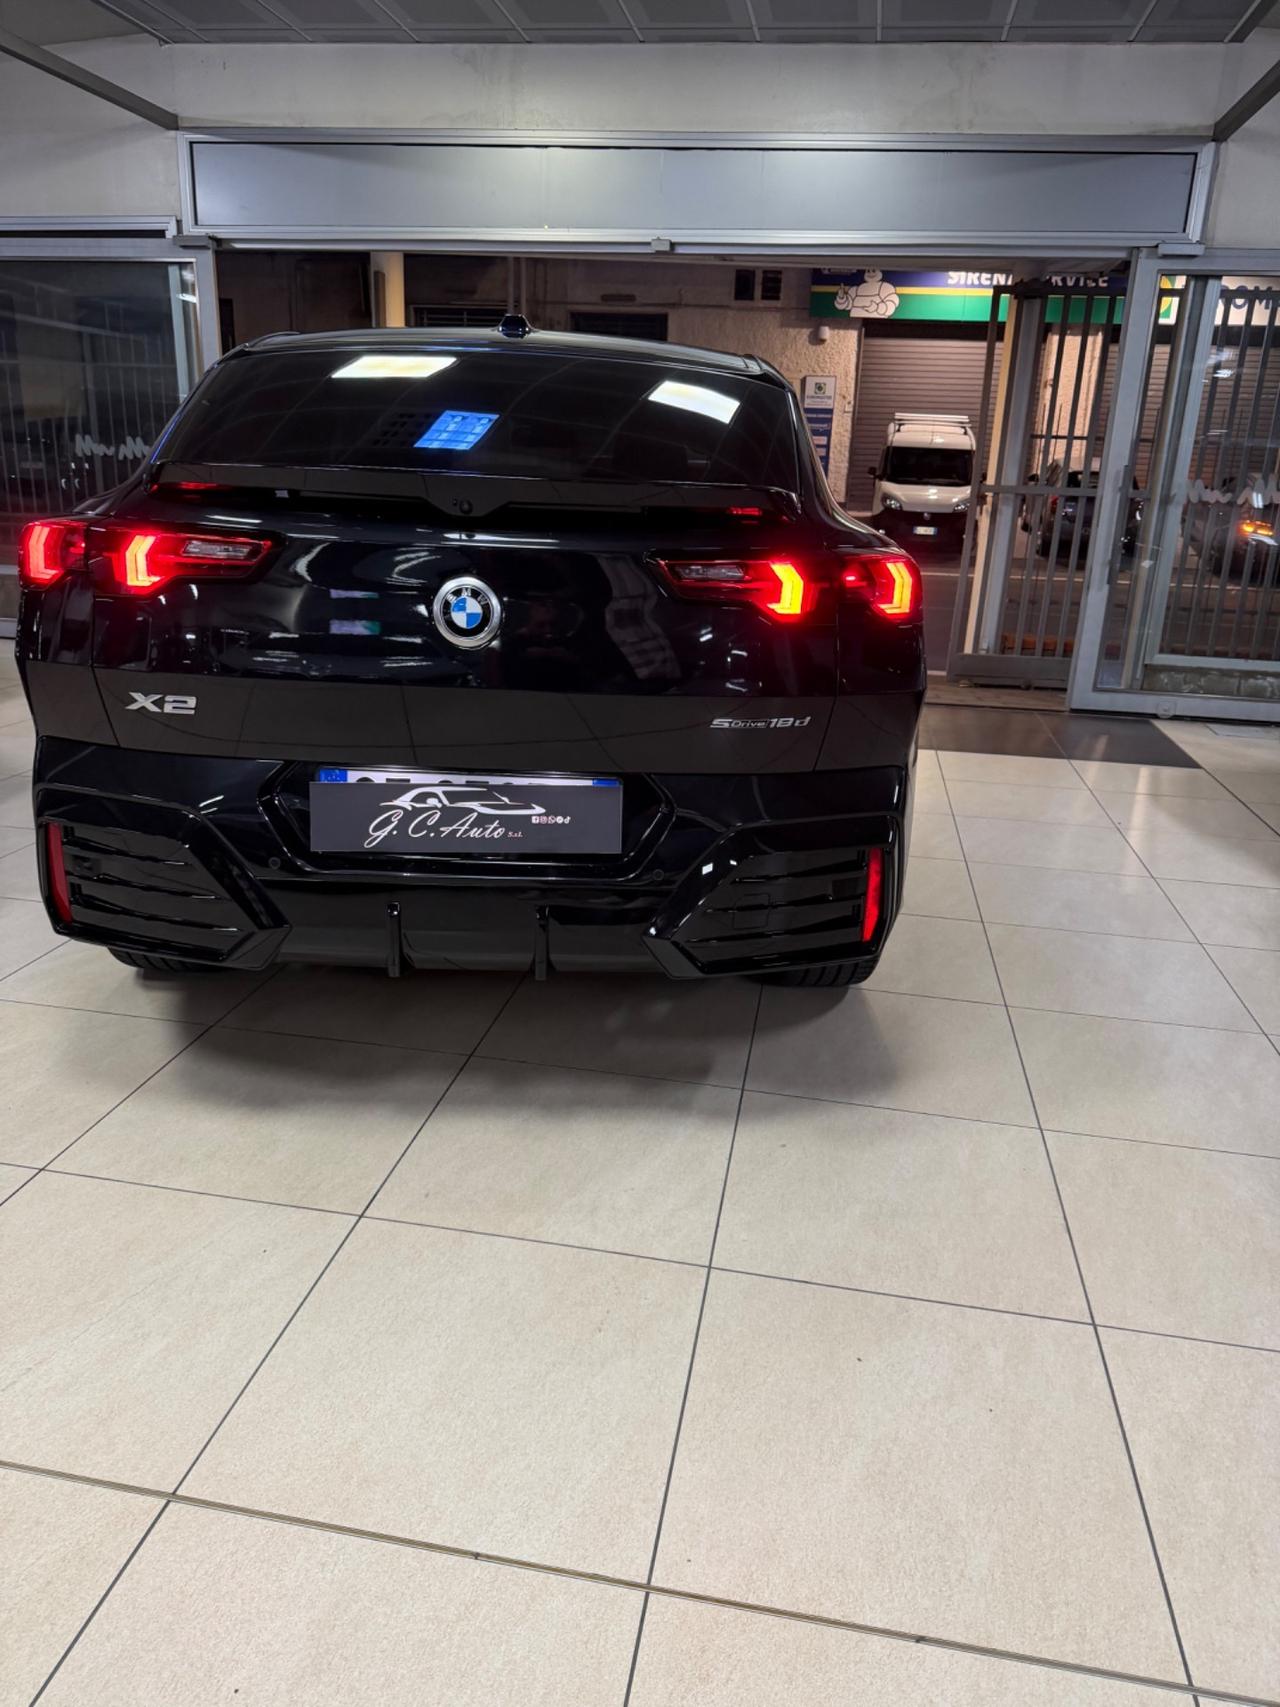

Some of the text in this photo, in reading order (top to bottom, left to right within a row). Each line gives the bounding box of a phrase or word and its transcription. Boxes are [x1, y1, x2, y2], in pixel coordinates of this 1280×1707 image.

[446, 587, 490, 605] BMW
[124, 692, 197, 715] X2
[440, 812, 506, 839] Auto
